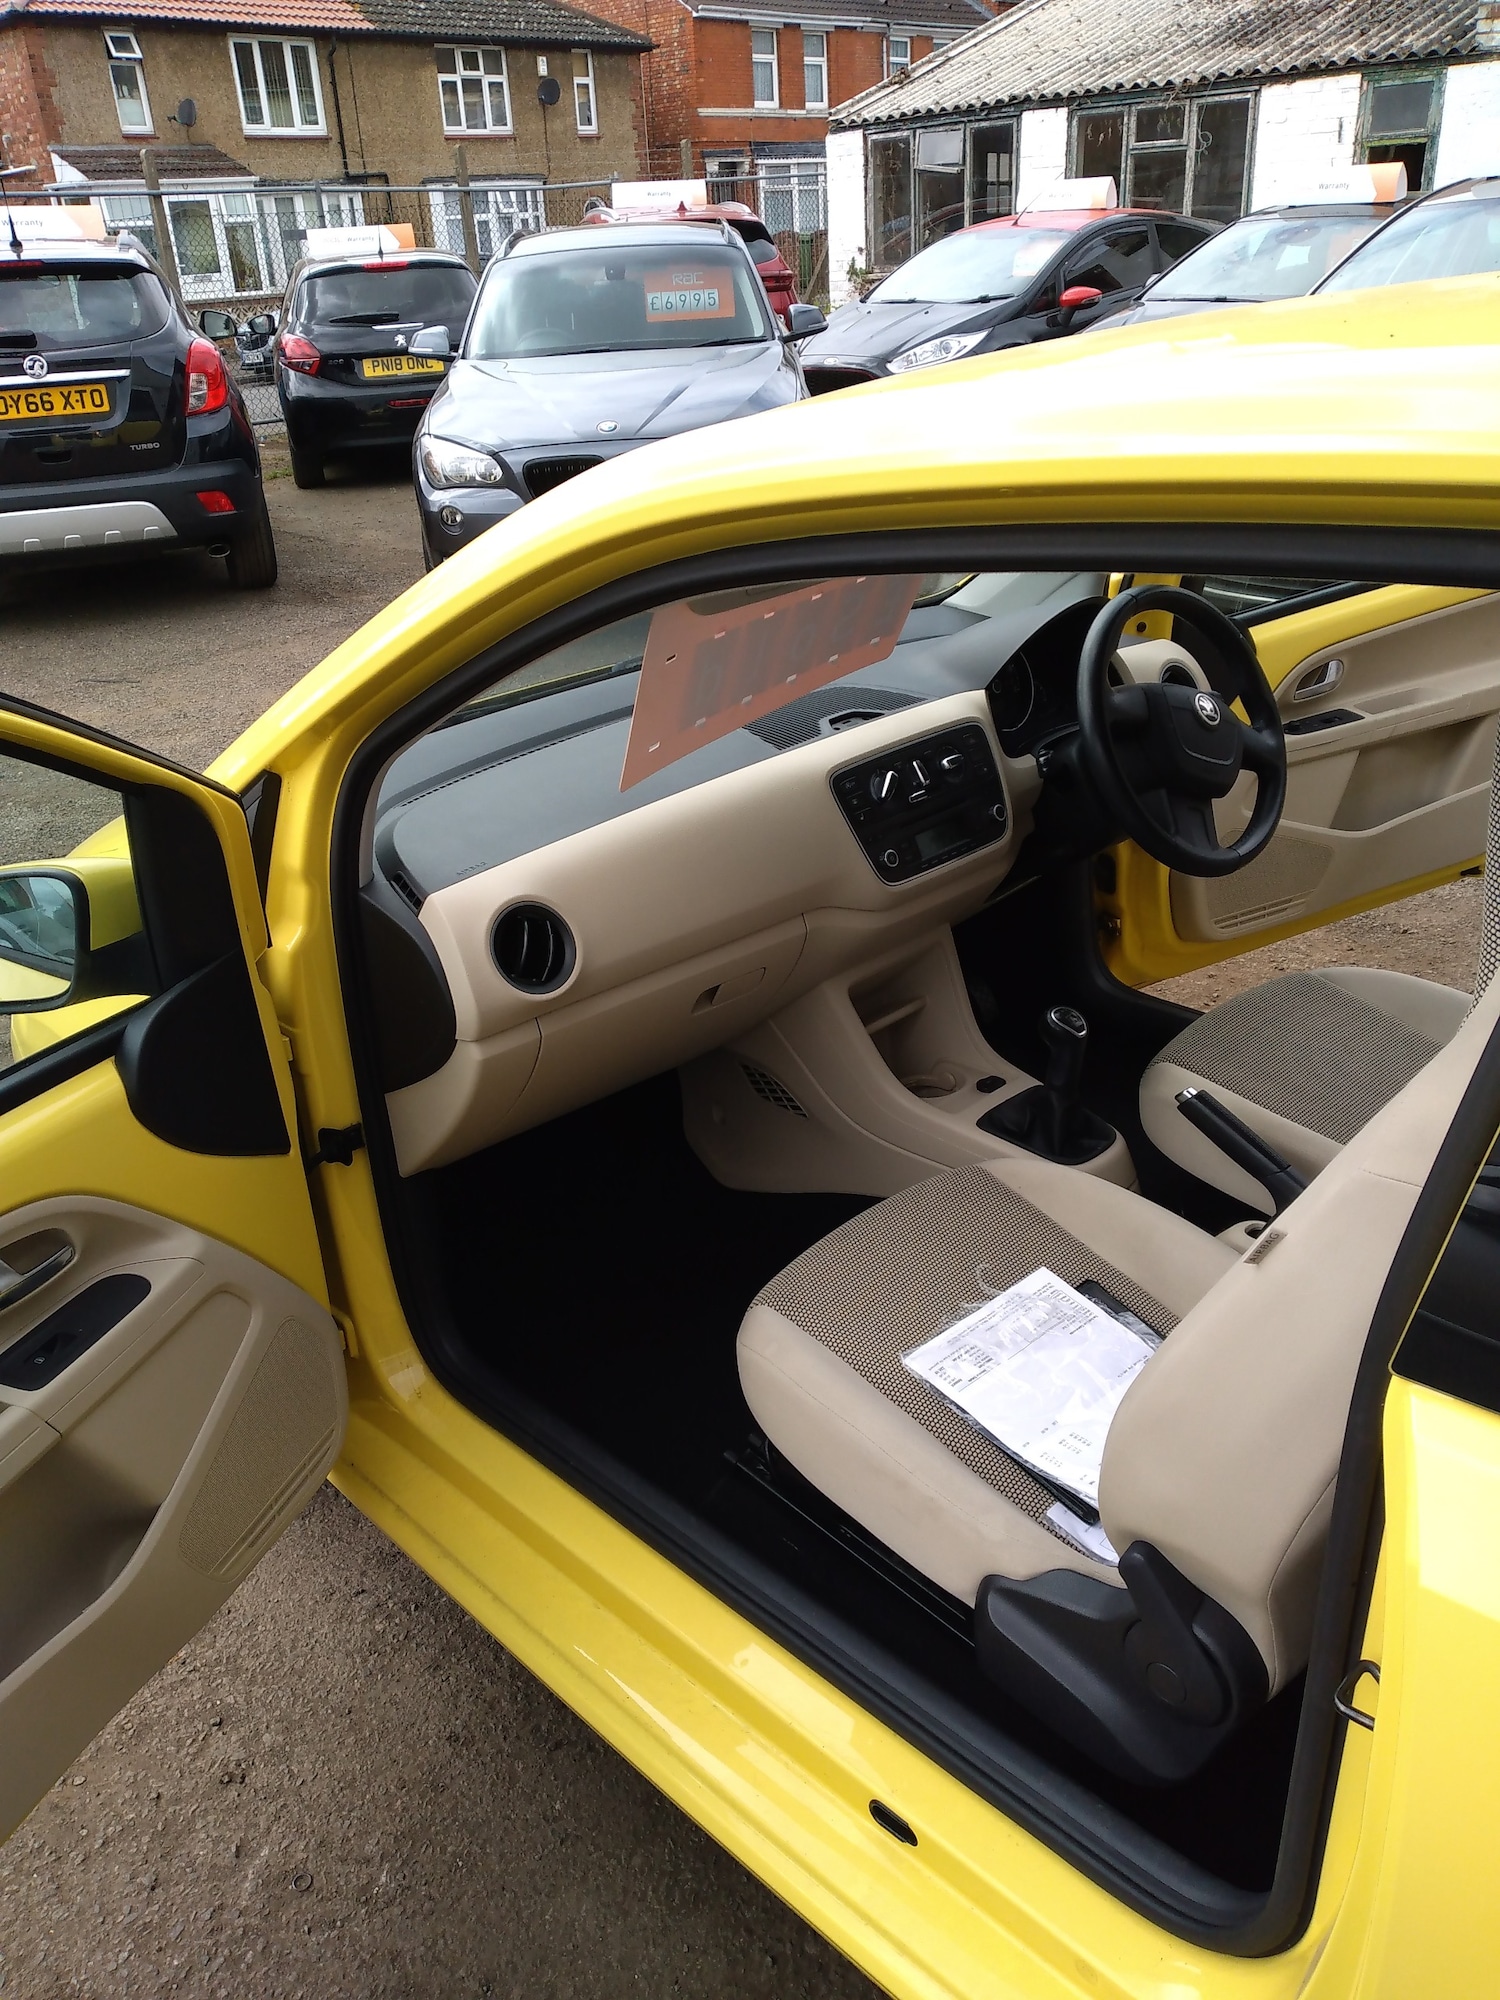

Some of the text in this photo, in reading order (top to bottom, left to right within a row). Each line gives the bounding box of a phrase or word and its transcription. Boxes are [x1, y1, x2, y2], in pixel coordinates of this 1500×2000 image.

[1318, 182, 1350, 190] Warranty
[650, 292, 717, 311] £6995
[371, 359, 403, 373] PN18
[59, 388, 105, 410] XTO
[129, 442, 161, 451] TURBO
[1249, 1232, 1280, 1262] AIRBAG
